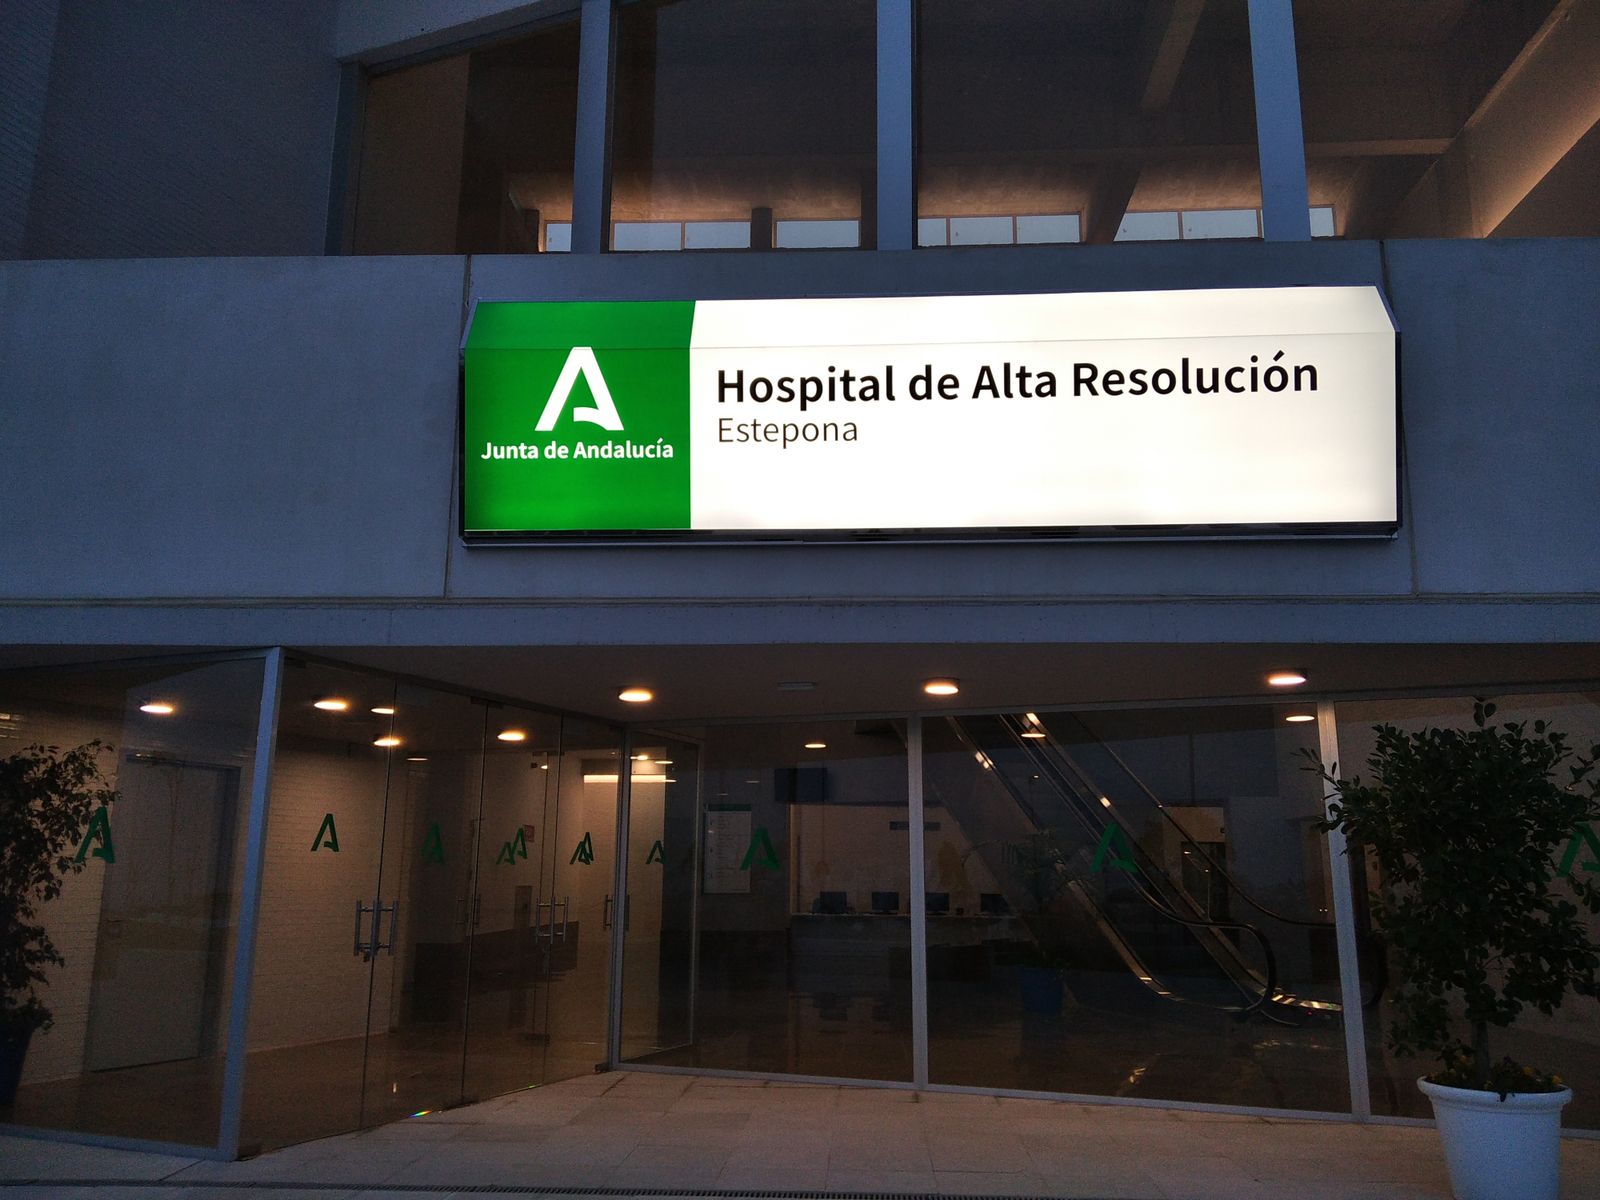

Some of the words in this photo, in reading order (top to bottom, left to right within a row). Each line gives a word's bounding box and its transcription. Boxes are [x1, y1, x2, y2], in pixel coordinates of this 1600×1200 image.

[719, 365, 895, 411] Hospital
[908, 364, 959, 400] de
[972, 363, 1056, 398] Alta
[1073, 350, 1317, 397] Resolución
[480, 442, 538, 460] Junta
[543, 441, 569, 459] de
[573, 438, 674, 459] Andalucía
[719, 418, 857, 449] Estepona
